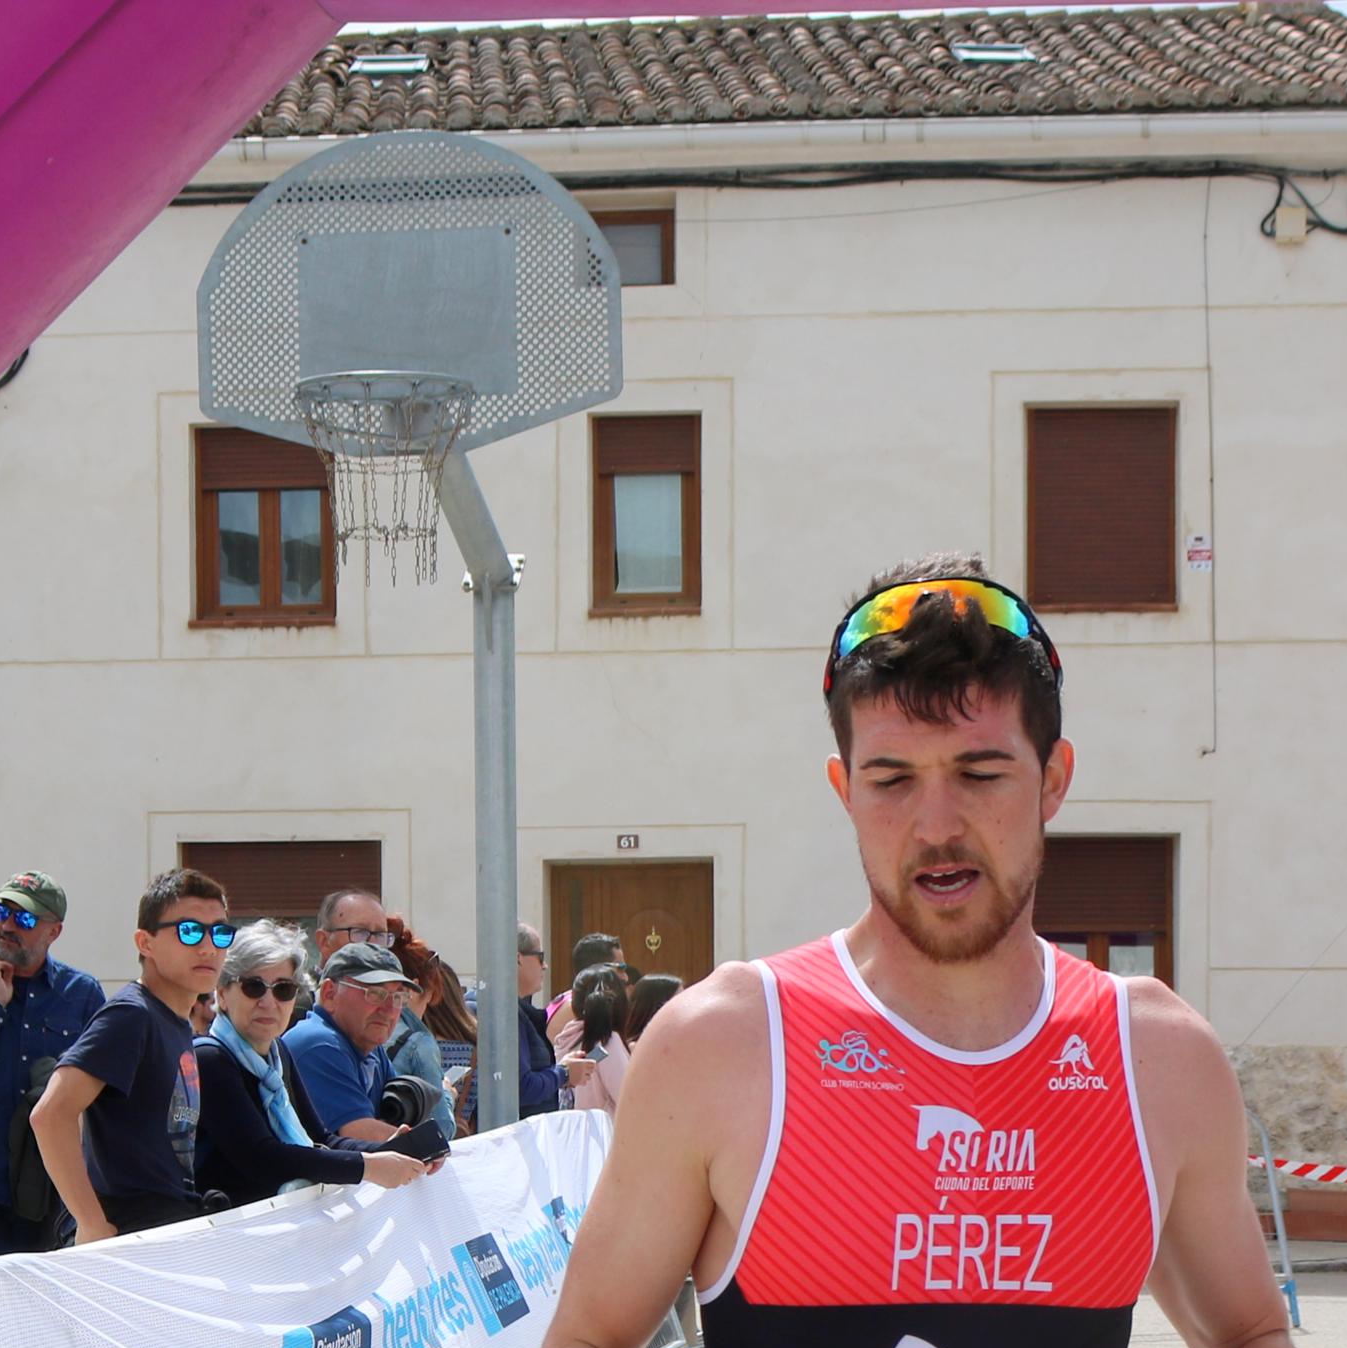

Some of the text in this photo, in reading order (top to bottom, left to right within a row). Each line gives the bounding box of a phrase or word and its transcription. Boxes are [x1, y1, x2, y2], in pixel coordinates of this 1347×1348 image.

[620, 836, 635, 849] 61
[1048, 1074, 1109, 1091] austral
[939, 1128, 1036, 1173] SORIA
[934, 1175, 1036, 1191] CIUDAD DEL DEPORTE
[890, 1195, 1053, 1293] PÉREZ
